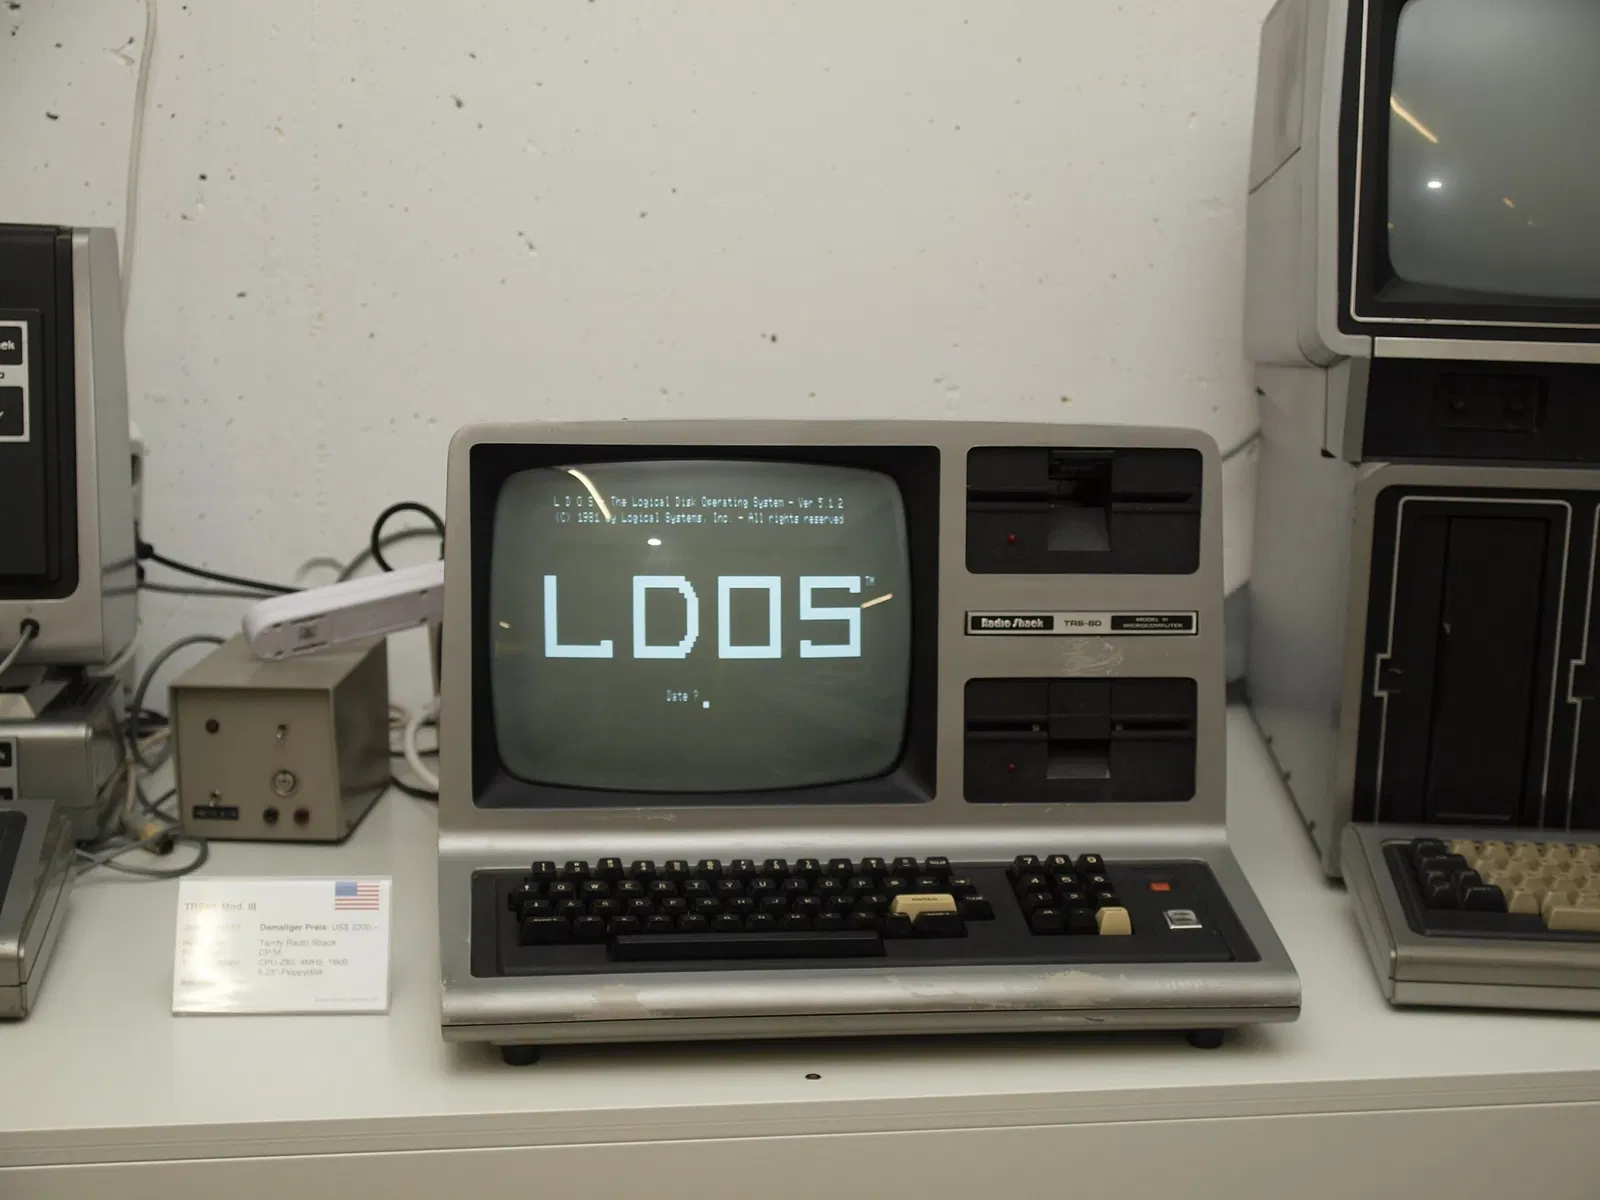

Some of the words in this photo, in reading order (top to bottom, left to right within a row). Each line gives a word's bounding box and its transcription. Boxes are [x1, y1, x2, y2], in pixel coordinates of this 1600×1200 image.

[611, 495, 627, 507] The
[632, 495, 670, 508] Logical
[675, 495, 697, 507] Disk
[702, 496, 748, 509] Operating
[753, 496, 785, 509] System
[798, 496, 813, 508] Ver
[621, 511, 660, 524] Logical
[748, 512, 764, 524] All
[768, 512, 800, 525] rights
[803, 513, 845, 525] reserved
[544, 575, 862, 659] LDOS
[980, 617, 1011, 628] Radio
[1011, 617, 1045, 628] Shack
[1063, 619, 1102, 627] TRS-80
